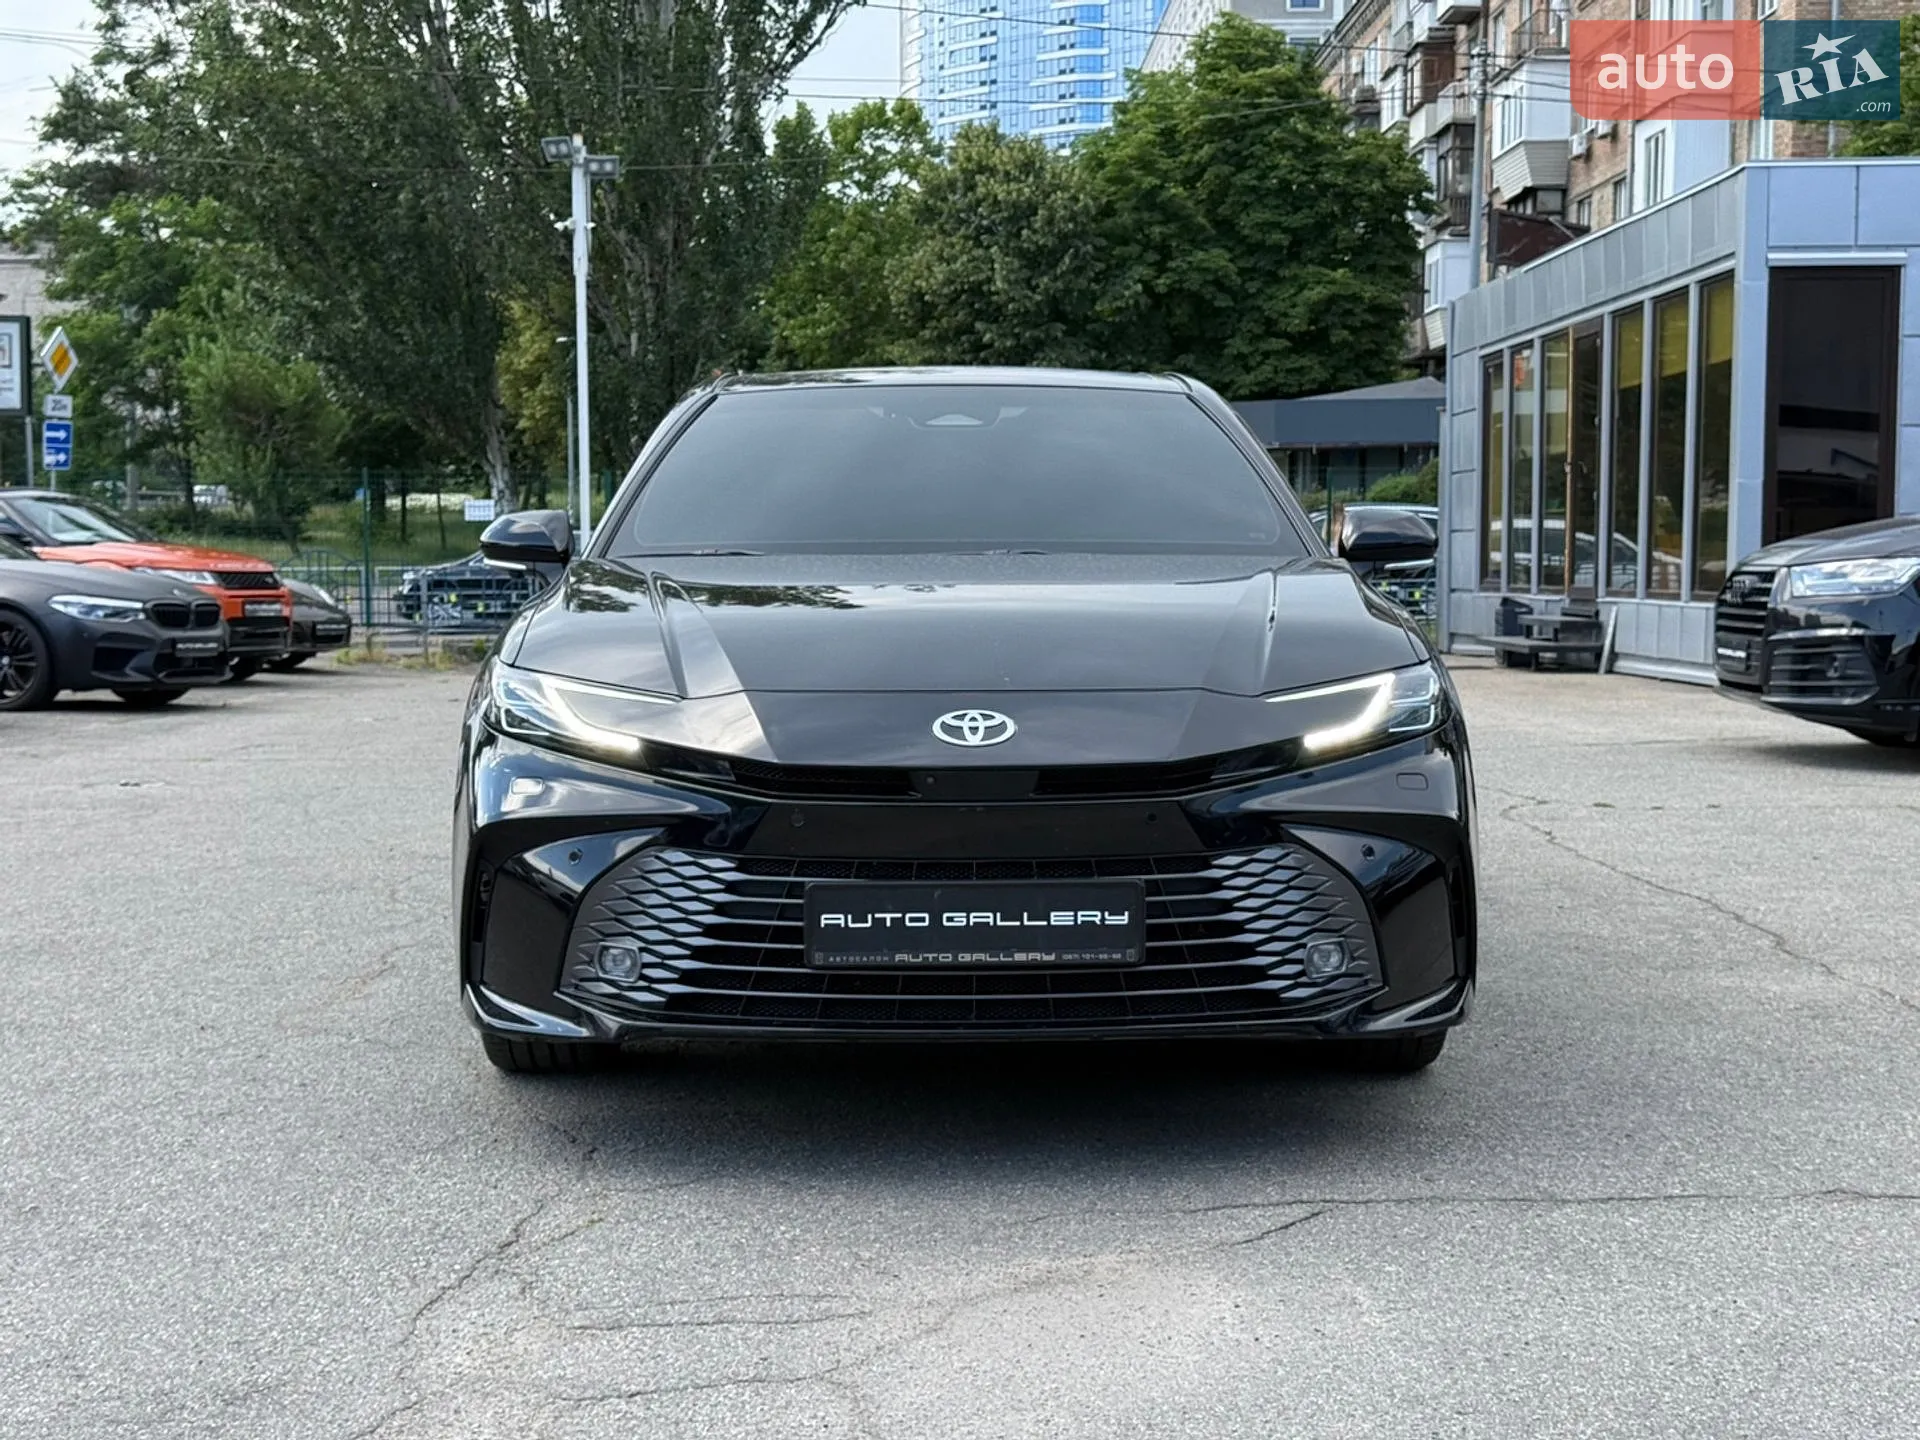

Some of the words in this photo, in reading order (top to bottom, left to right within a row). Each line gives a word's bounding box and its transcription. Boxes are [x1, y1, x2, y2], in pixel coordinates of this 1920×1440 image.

[820, 912, 929, 928] AUTO
[942, 910, 1129, 927] GALLERY
[895, 953, 953, 963] AUTO
[958, 952, 1056, 963] GALLERY
